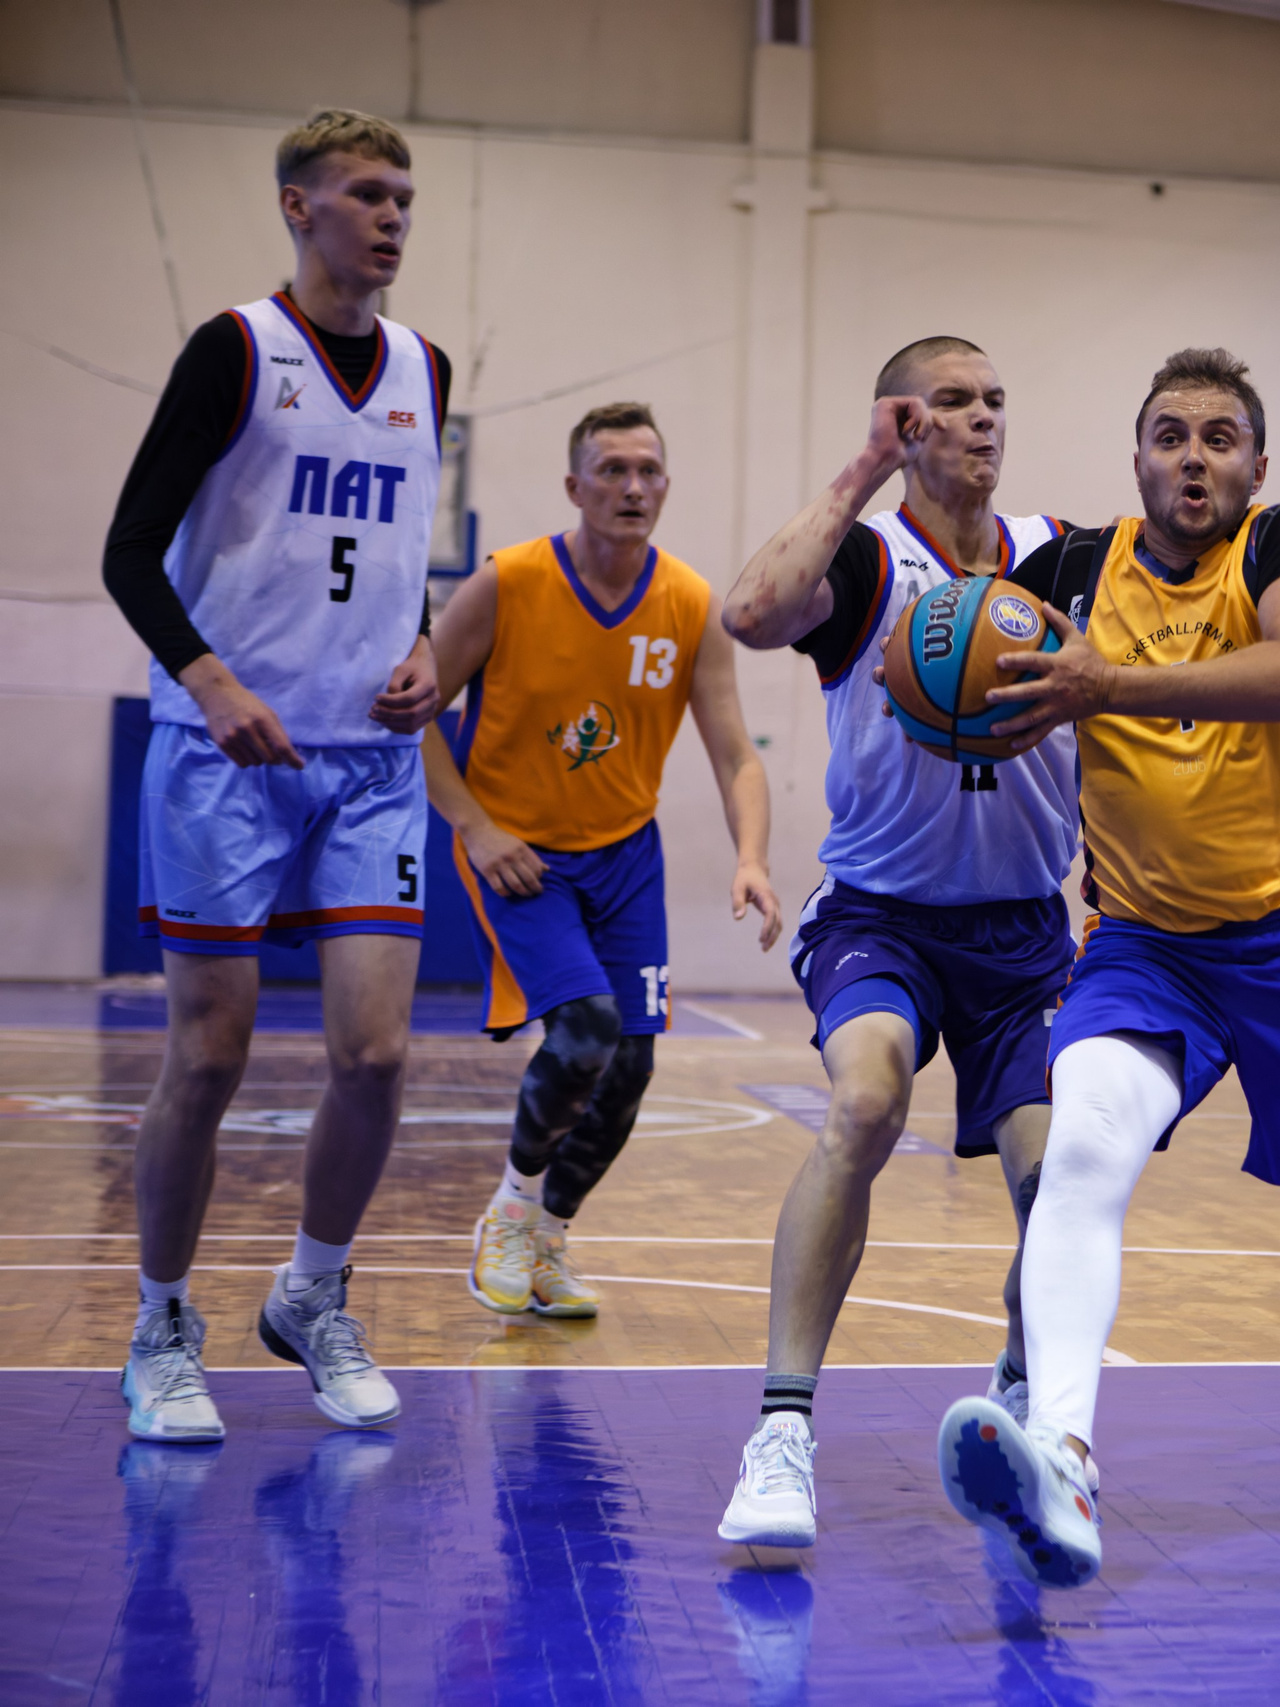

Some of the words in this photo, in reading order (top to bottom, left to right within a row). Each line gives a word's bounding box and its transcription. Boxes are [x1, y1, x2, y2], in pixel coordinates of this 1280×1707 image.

[288, 455, 406, 523] ПАТ
[329, 536, 357, 603] 5
[923, 578, 970, 665] Wilso
[1120, 621, 1238, 667] SKETBALL.PRM.R
[628, 635, 678, 689] 13
[397, 854, 418, 902] 5
